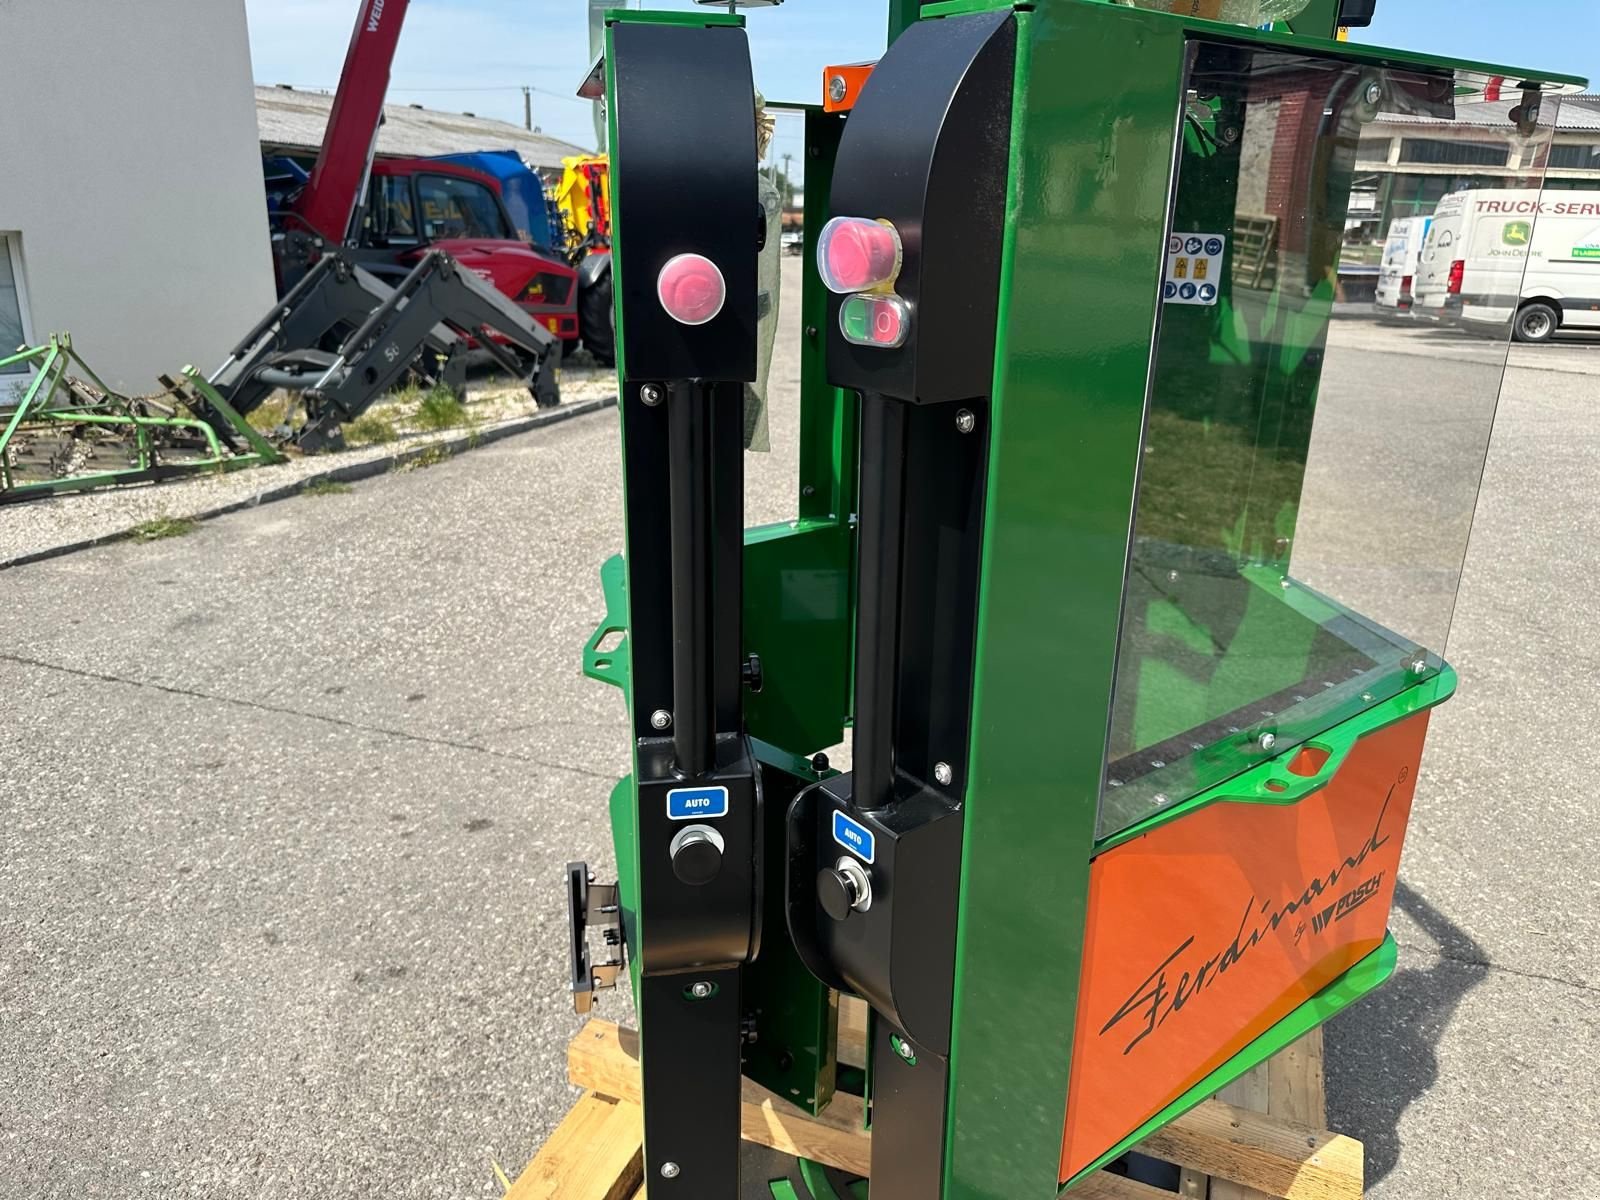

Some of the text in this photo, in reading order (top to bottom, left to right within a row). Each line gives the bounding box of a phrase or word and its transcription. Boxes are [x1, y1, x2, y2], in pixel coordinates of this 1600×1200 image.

[685, 798, 710, 808] AUTO
[844, 827, 862, 846] AUTO
[1099, 783, 1396, 1055] Ferdinand
